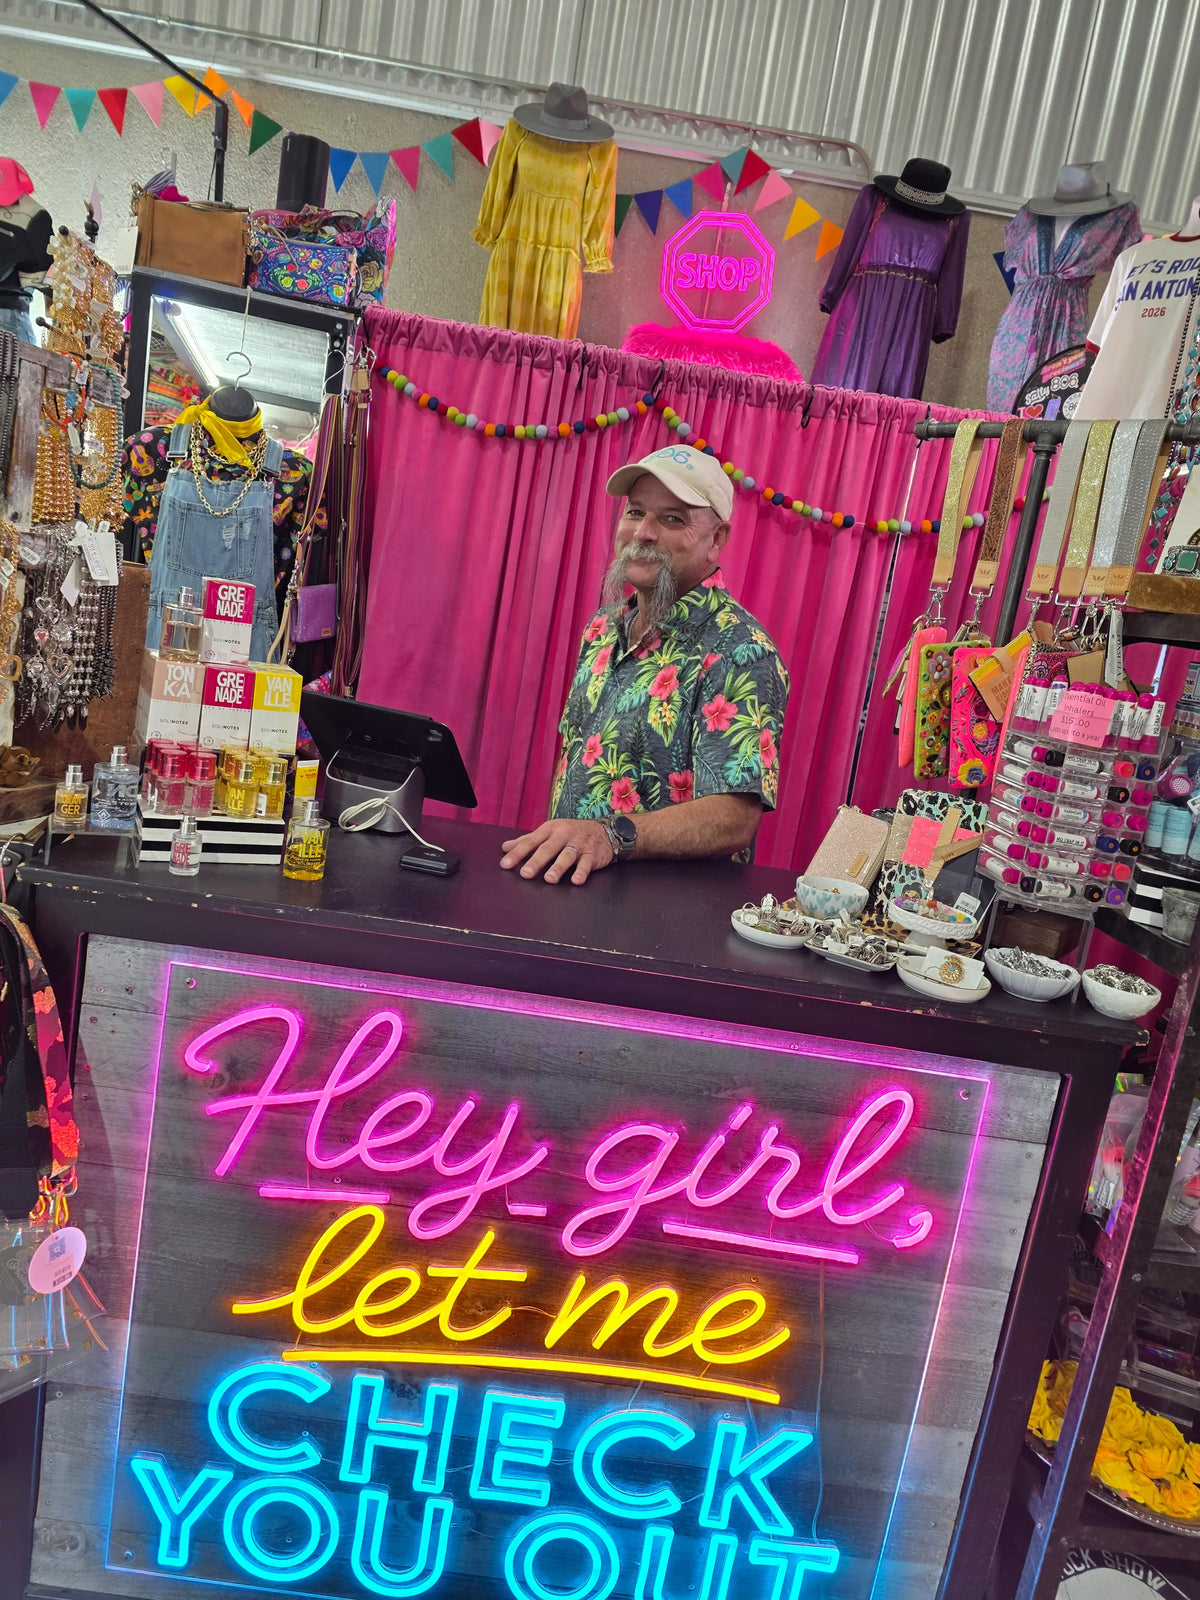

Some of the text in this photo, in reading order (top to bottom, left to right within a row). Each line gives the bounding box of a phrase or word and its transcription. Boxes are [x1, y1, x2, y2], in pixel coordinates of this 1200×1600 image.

[675, 253, 761, 292] SHOP
[1126, 256, 1200, 280] ET'S ROC
[1139, 277, 1200, 301] ANTON
[1141, 307, 1167, 318] 2026
[1050, 373, 1079, 391] 806
[1025, 386, 1050, 406] Salty
[217, 584, 246, 603] GRE
[216, 602, 244, 619] NADE
[213, 637, 241, 645] SOLINOTES
[166, 664, 195, 683] TON
[216, 671, 245, 689] GRE
[163, 680, 192, 699] KA
[266, 675, 292, 693] VAN
[214, 687, 244, 705] NADE
[263, 690, 292, 708] ILLE
[1095, 697, 1106, 707] Oil
[160, 718, 189, 726] SOLINOTES
[212, 723, 240, 731] SOLINOTES
[1085, 733, 1101, 741] year
[61, 804, 80, 815] GER
[302, 829, 325, 845] VAN
[174, 842, 191, 853] GRE
[298, 843, 322, 858] ILLE
[184, 1005, 934, 1257] Hey girl,
[231, 1204, 791, 1365] let me
[207, 1359, 814, 1538] CHECK
[130, 1452, 841, 1600] YOU OUT
[1062, 1547, 1167, 1591] OCK SHOW
